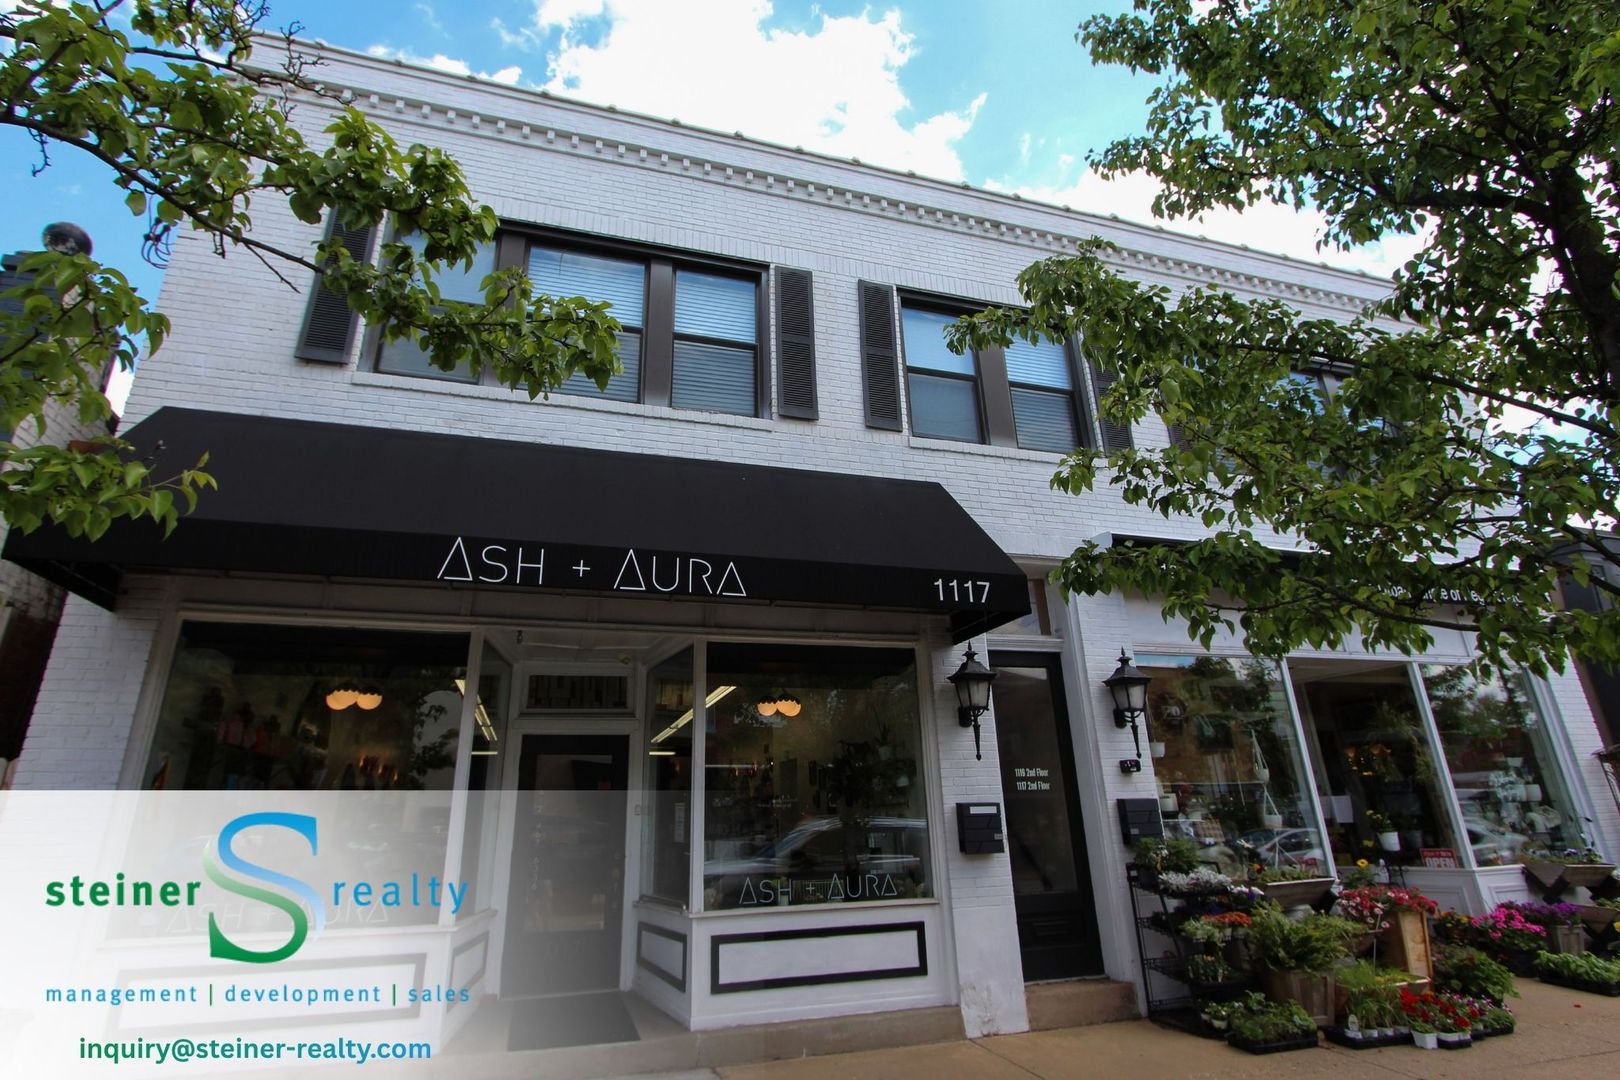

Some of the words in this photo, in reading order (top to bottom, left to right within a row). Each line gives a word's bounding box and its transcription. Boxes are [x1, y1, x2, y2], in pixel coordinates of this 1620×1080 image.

[437, 537, 545, 585] ASH
[572, 560, 591, 577] +
[613, 549, 747, 597] AURA
[934, 578, 990, 603] 1117
[1026, 768, 1036, 776] 2nd
[1017, 781, 1026, 791] 1117
[1027, 781, 1037, 791] 2nd
[738, 877, 793, 905] ASH
[827, 873, 898, 900] AURA
